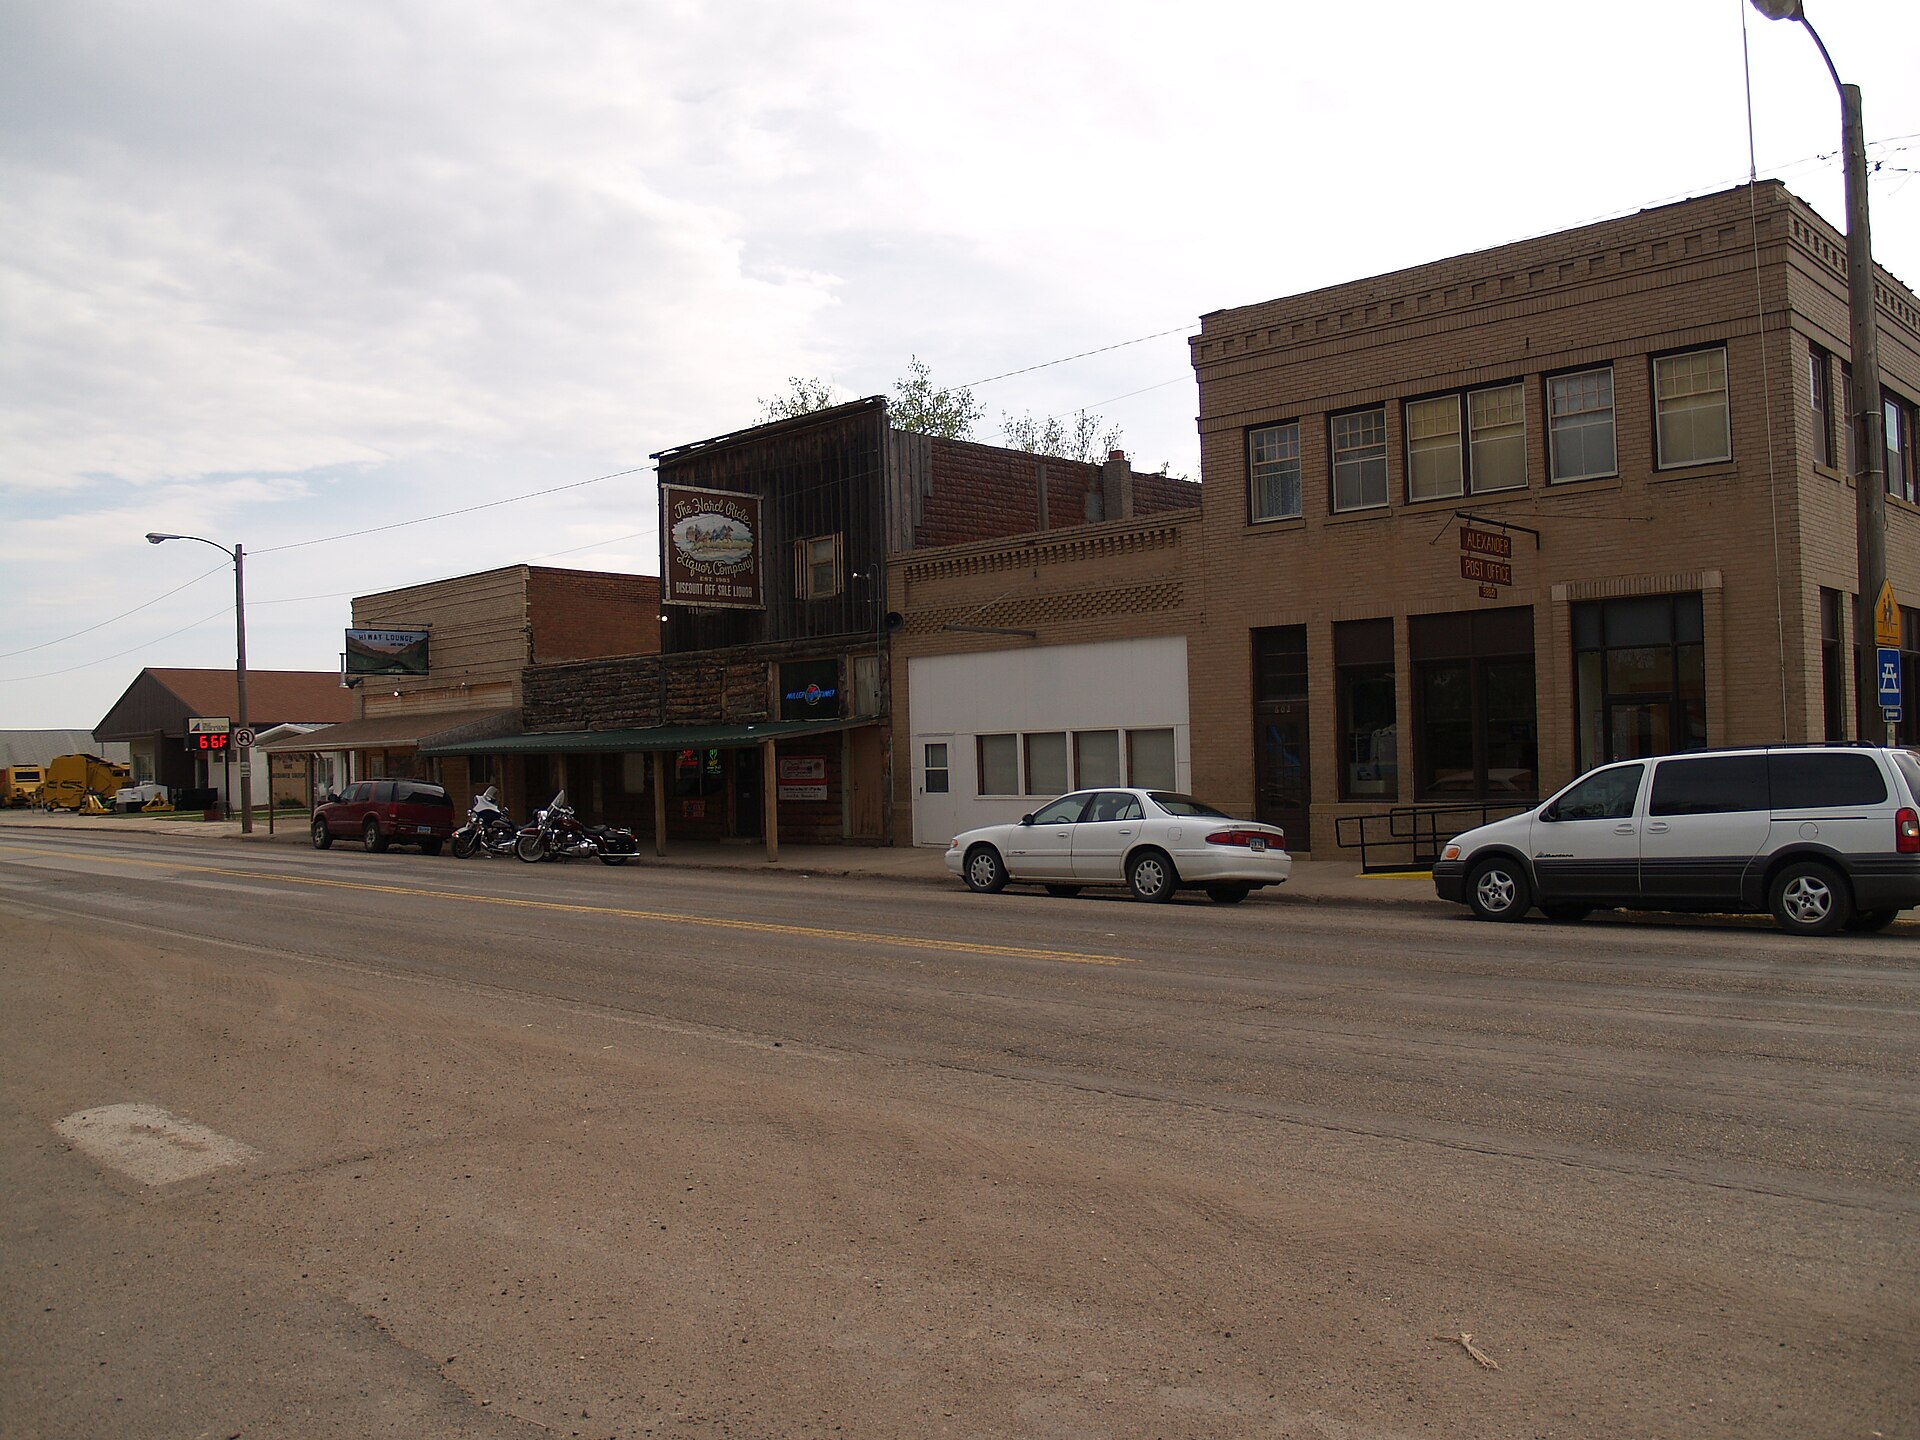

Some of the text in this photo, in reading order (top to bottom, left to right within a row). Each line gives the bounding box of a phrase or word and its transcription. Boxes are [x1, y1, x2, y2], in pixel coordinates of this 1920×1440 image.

[674, 497, 752, 527] The Hard Ride
[1466, 532, 1509, 555] ALEXANDER
[676, 548, 754, 578] Liquor Company
[1465, 560, 1511, 583] POST OFFICE
[676, 582, 752, 598] DISCOUNT OFF SALE LIQUOR
[358, 633, 414, 643] HIWAY LOUNGE
[199, 735, 227, 749] 66F
